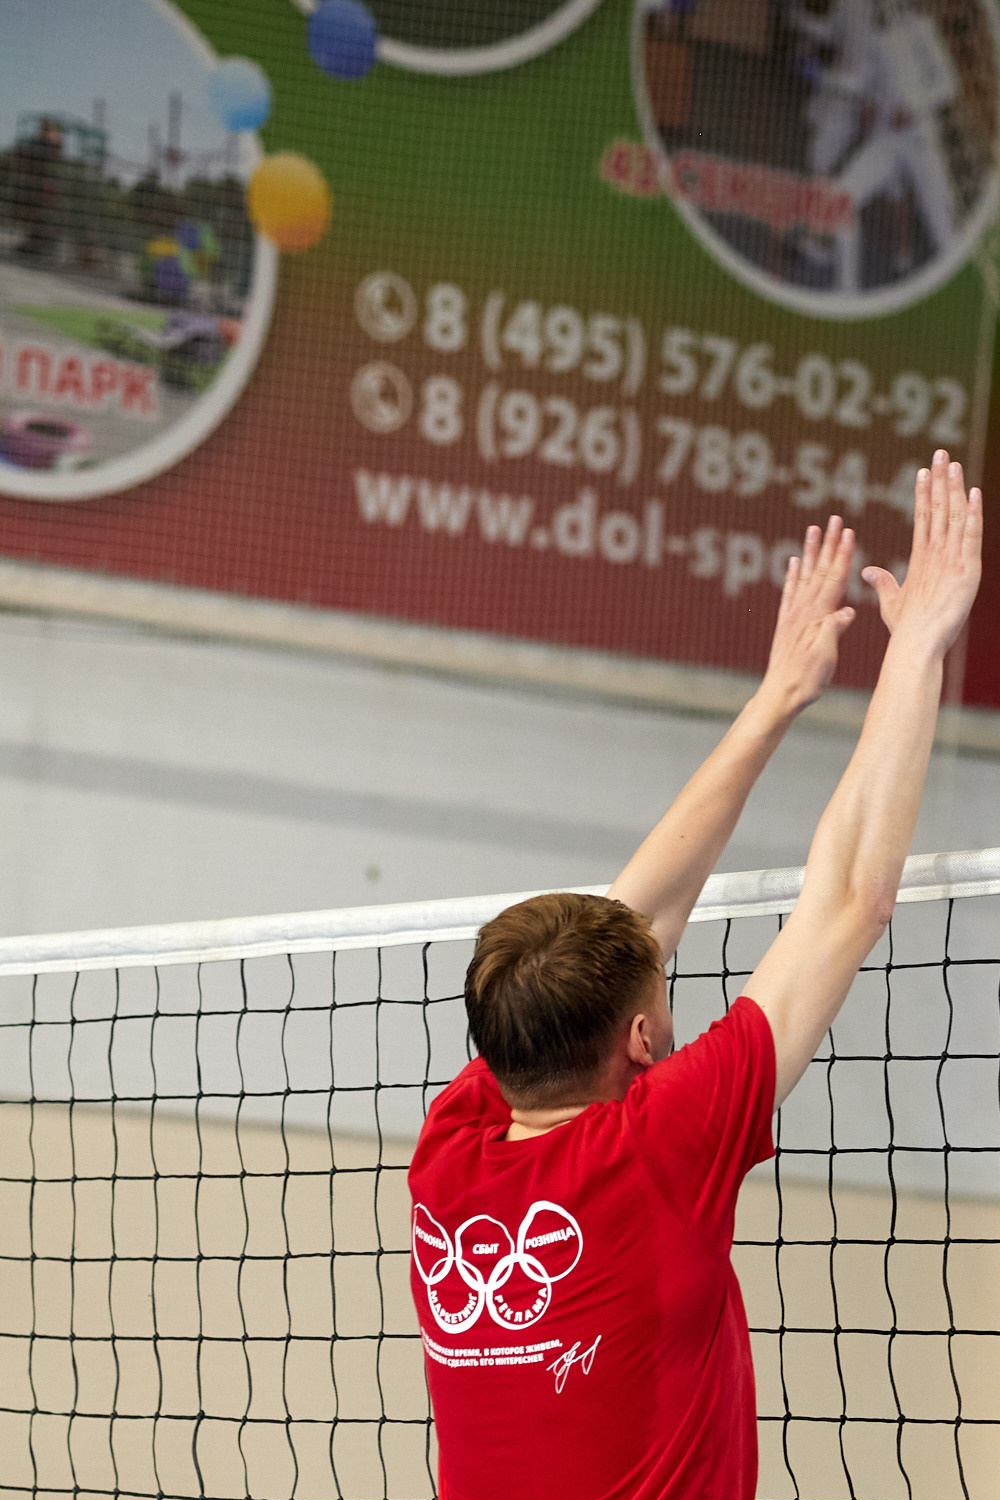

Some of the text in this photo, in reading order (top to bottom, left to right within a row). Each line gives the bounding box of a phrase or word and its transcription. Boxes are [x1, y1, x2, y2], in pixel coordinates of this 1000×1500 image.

[16, 348, 157, 412] ПАРК
[424, 282, 967, 445] 8 (495) 576-02-92
[420, 375, 917, 527] 8 (926) 789-54-4
[473, 1243, 499, 1254] СБЫТ
[525, 1227, 576, 1250] РОЗНИЦА
[430, 1290, 478, 1324] МАРКЕТИНГ
[494, 1287, 547, 1323] РЕКЛАМА
[447, 1358, 479, 1368] СДЕЛАТЬ
[480, 1358, 494, 1366] ЕГО
[495, 1353, 544, 1366] ИНТЕРЕСНЕЕ
[490, 1346, 525, 1356] КОТОРОЕ
